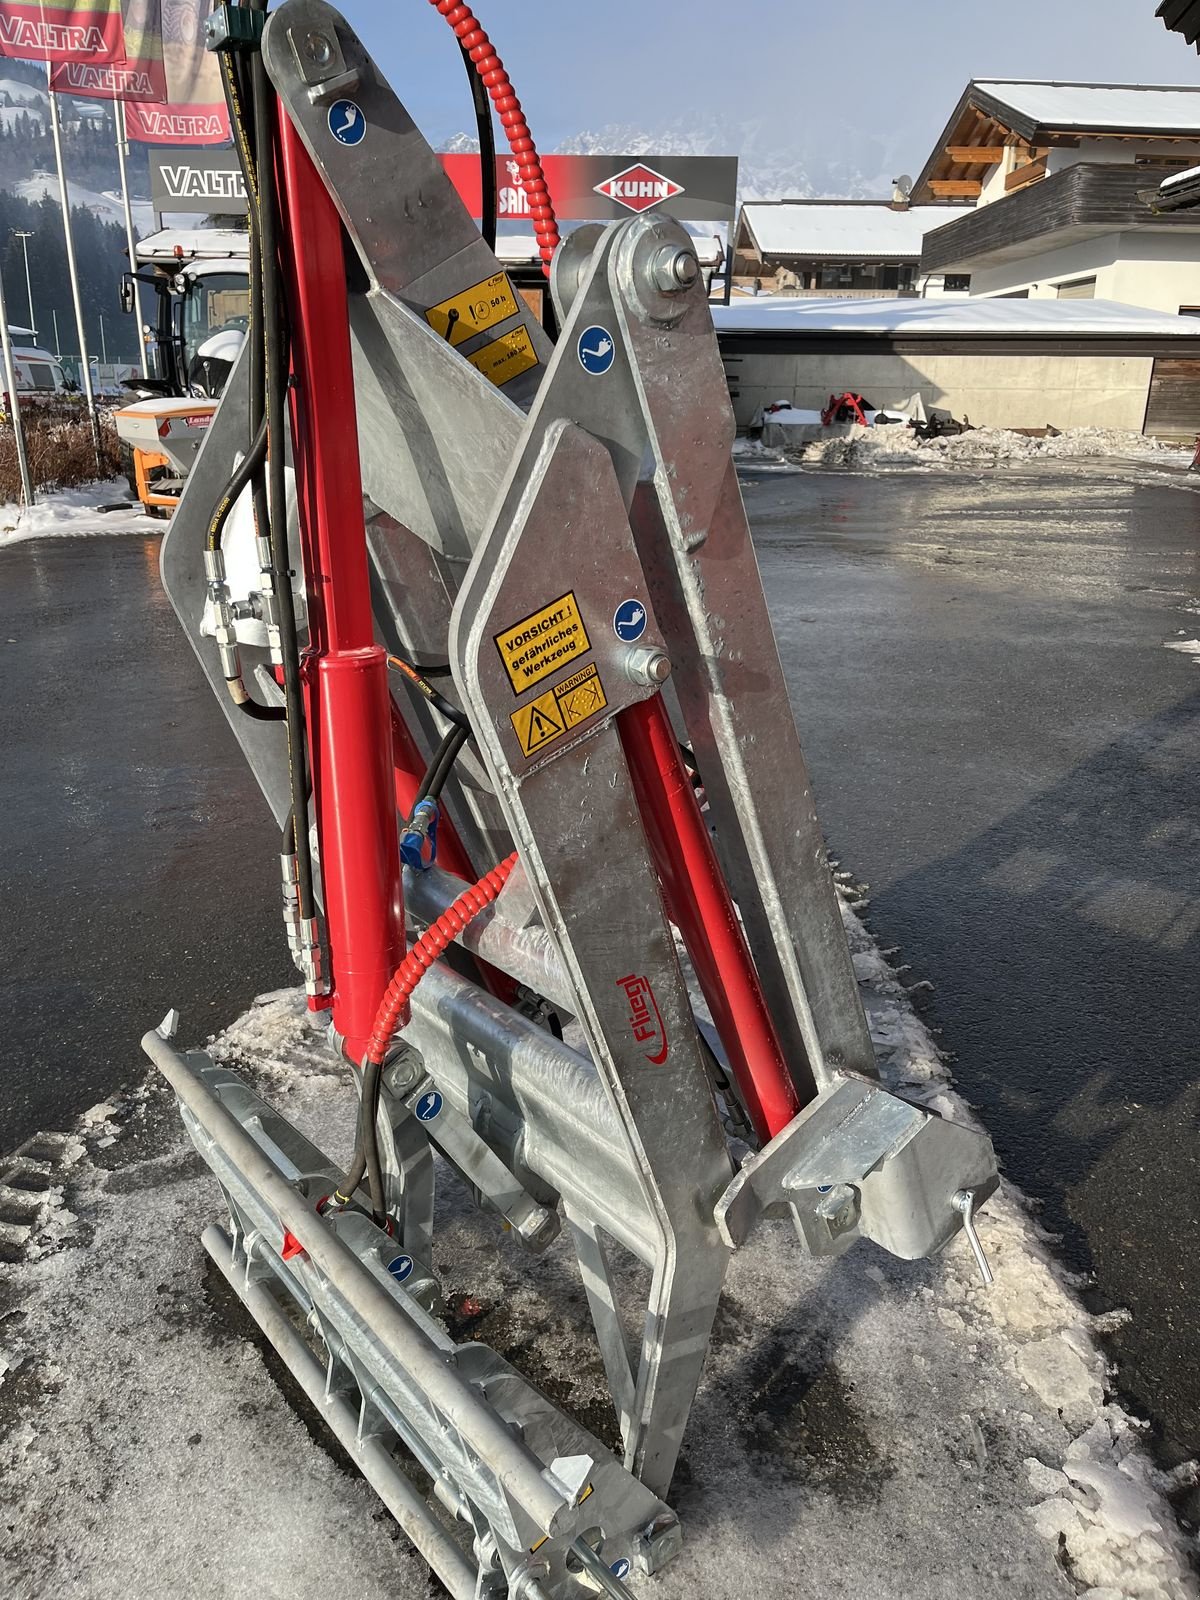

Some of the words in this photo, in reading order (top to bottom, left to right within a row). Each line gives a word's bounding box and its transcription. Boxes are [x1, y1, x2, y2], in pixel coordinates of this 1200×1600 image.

[0, 14, 108, 52] VALTRA
[66, 62, 153, 95] VALTRA
[139, 110, 223, 136] VALTRA
[609, 180, 669, 198] KUHN
[490, 298, 500, 308] 50
[493, 356, 507, 368] max.
[506, 611, 564, 651] VORSICHT
[511, 622, 579, 670] gefährliches
[522, 639, 577, 678] Werkzeug
[556, 666, 595, 694] WARNING!
[615, 973, 656, 1042] Fliegl
